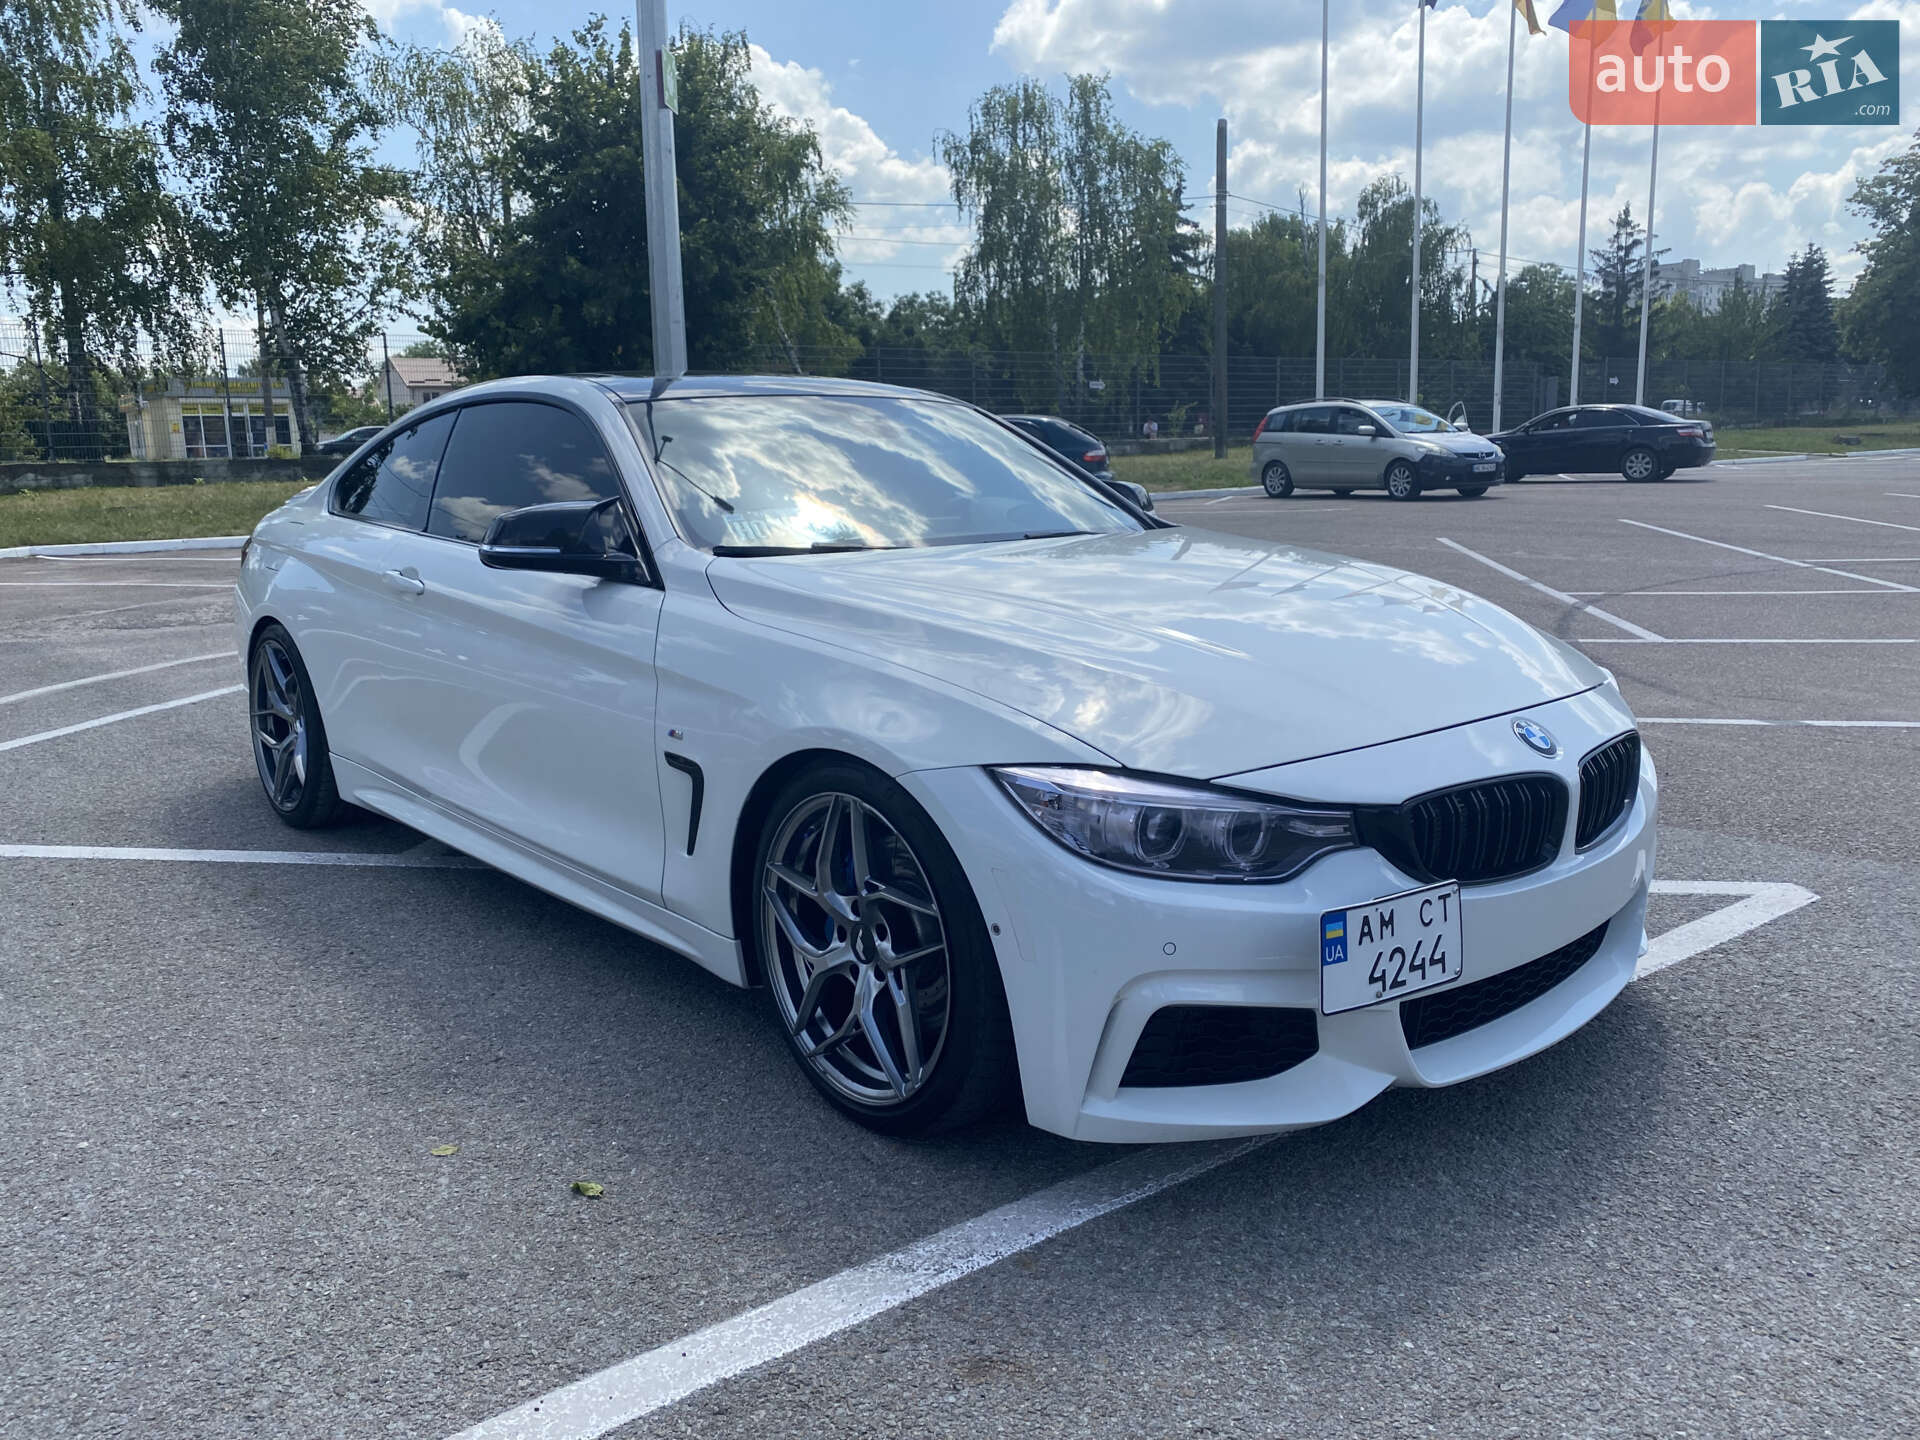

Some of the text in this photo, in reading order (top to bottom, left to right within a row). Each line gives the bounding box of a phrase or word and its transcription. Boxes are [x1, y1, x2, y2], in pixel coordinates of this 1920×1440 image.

[1358, 893, 1451, 946] AM CT
[1325, 945, 1344, 962] UA
[1368, 934, 1446, 993] 4244
